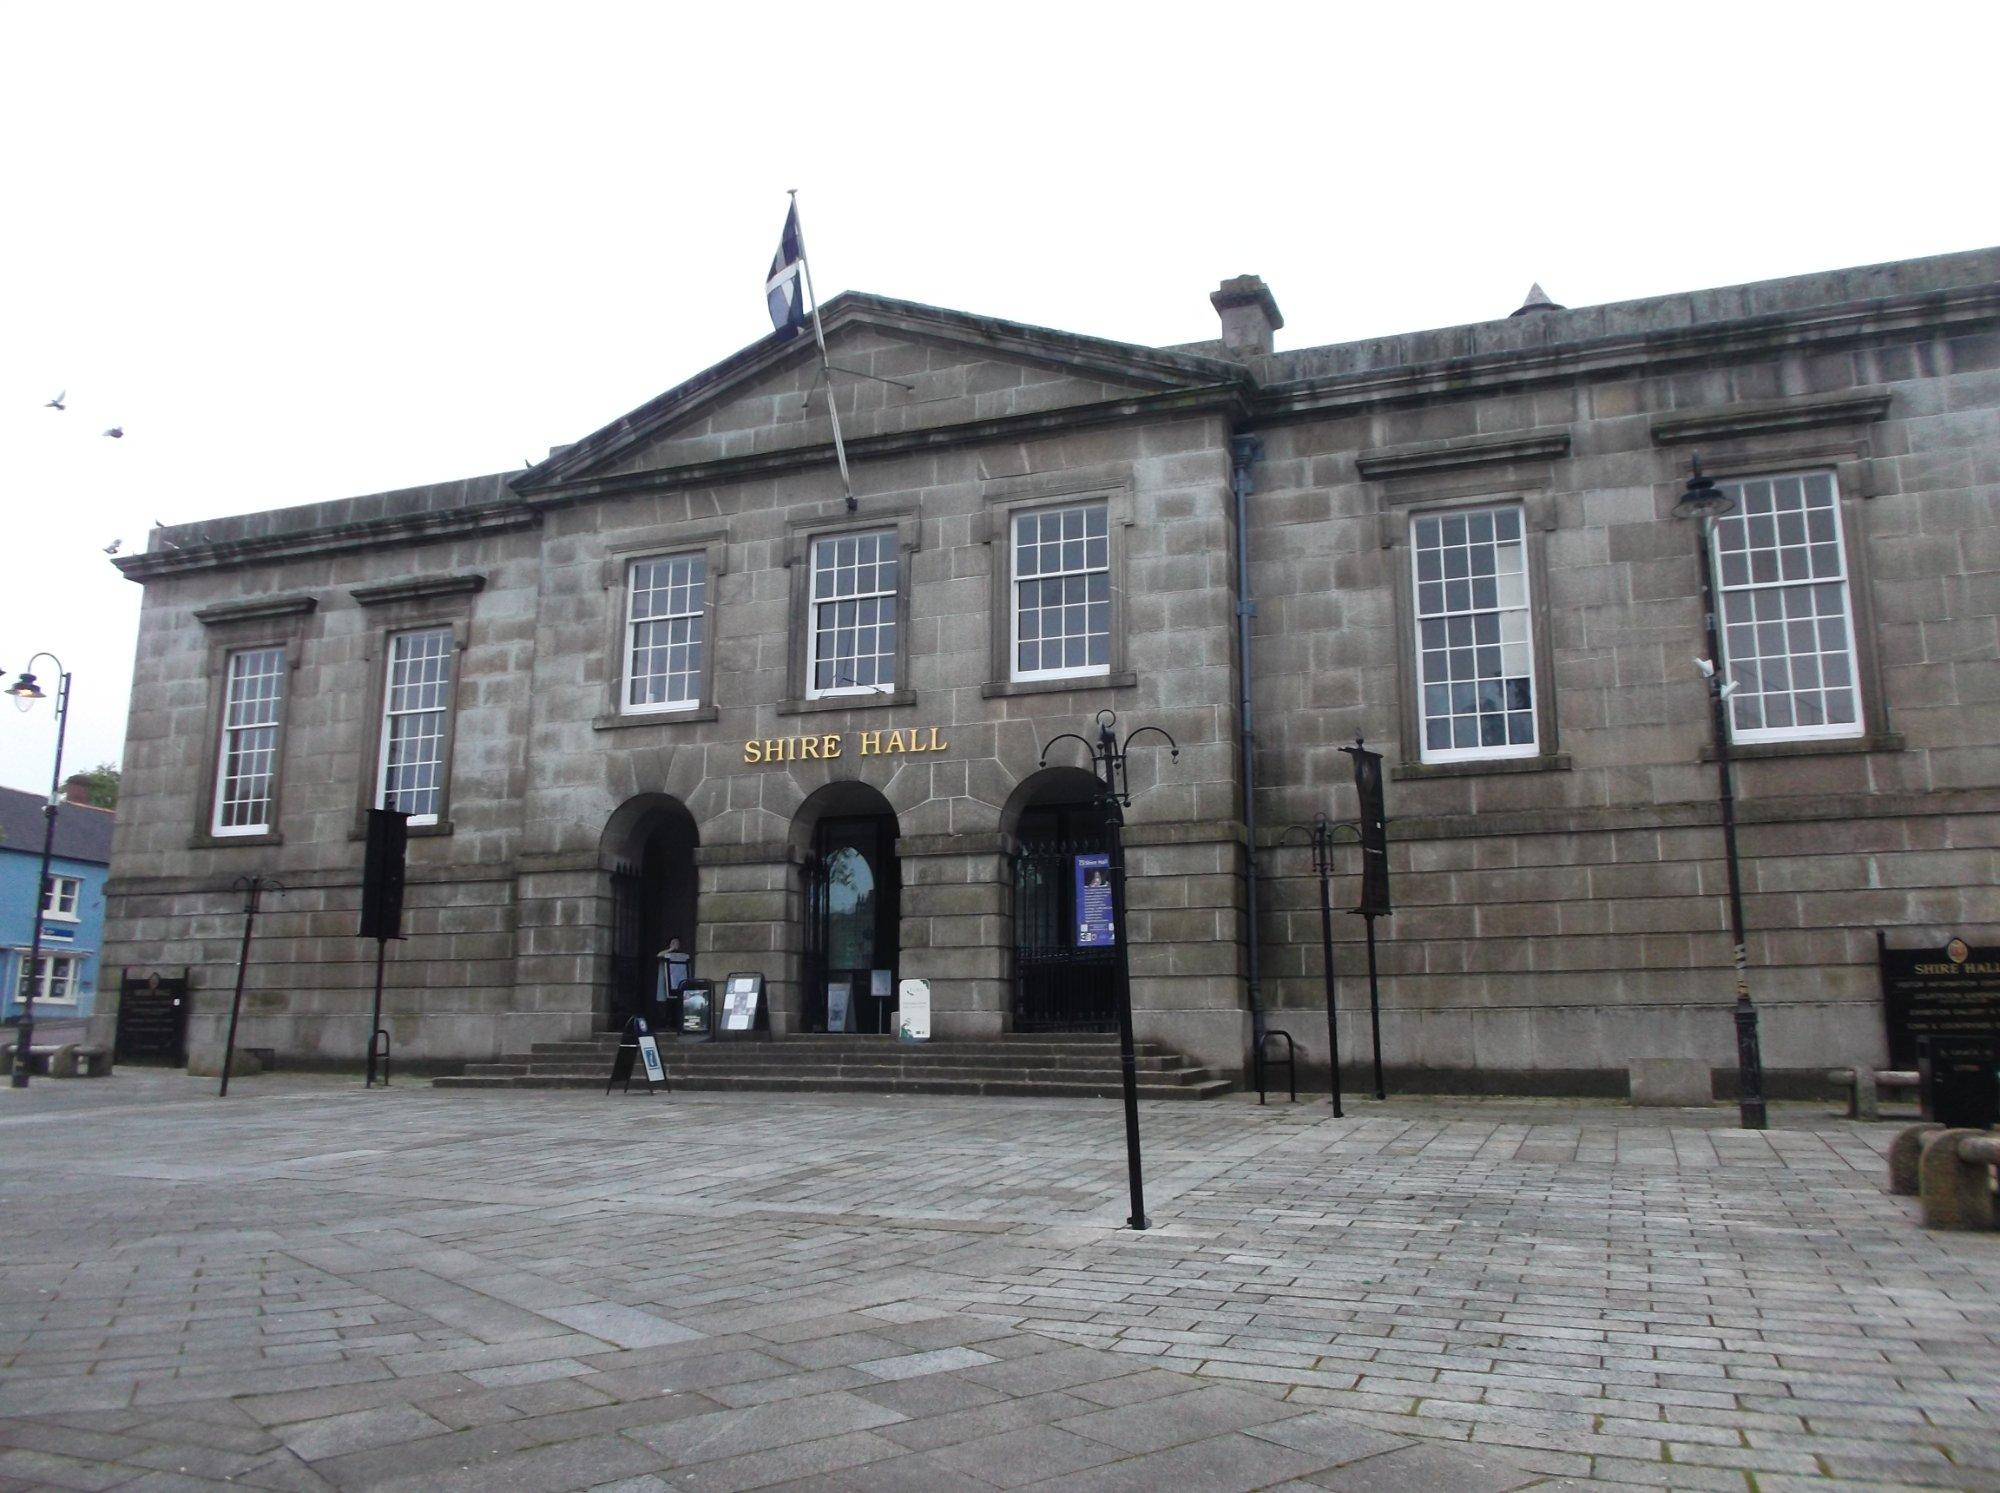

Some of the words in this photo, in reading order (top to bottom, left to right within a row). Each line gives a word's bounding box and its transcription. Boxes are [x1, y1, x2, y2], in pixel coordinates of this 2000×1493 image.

[743, 734, 842, 763] SHIRE
[860, 727, 948, 755] HALL
[1913, 963, 1959, 975] SHIRE
